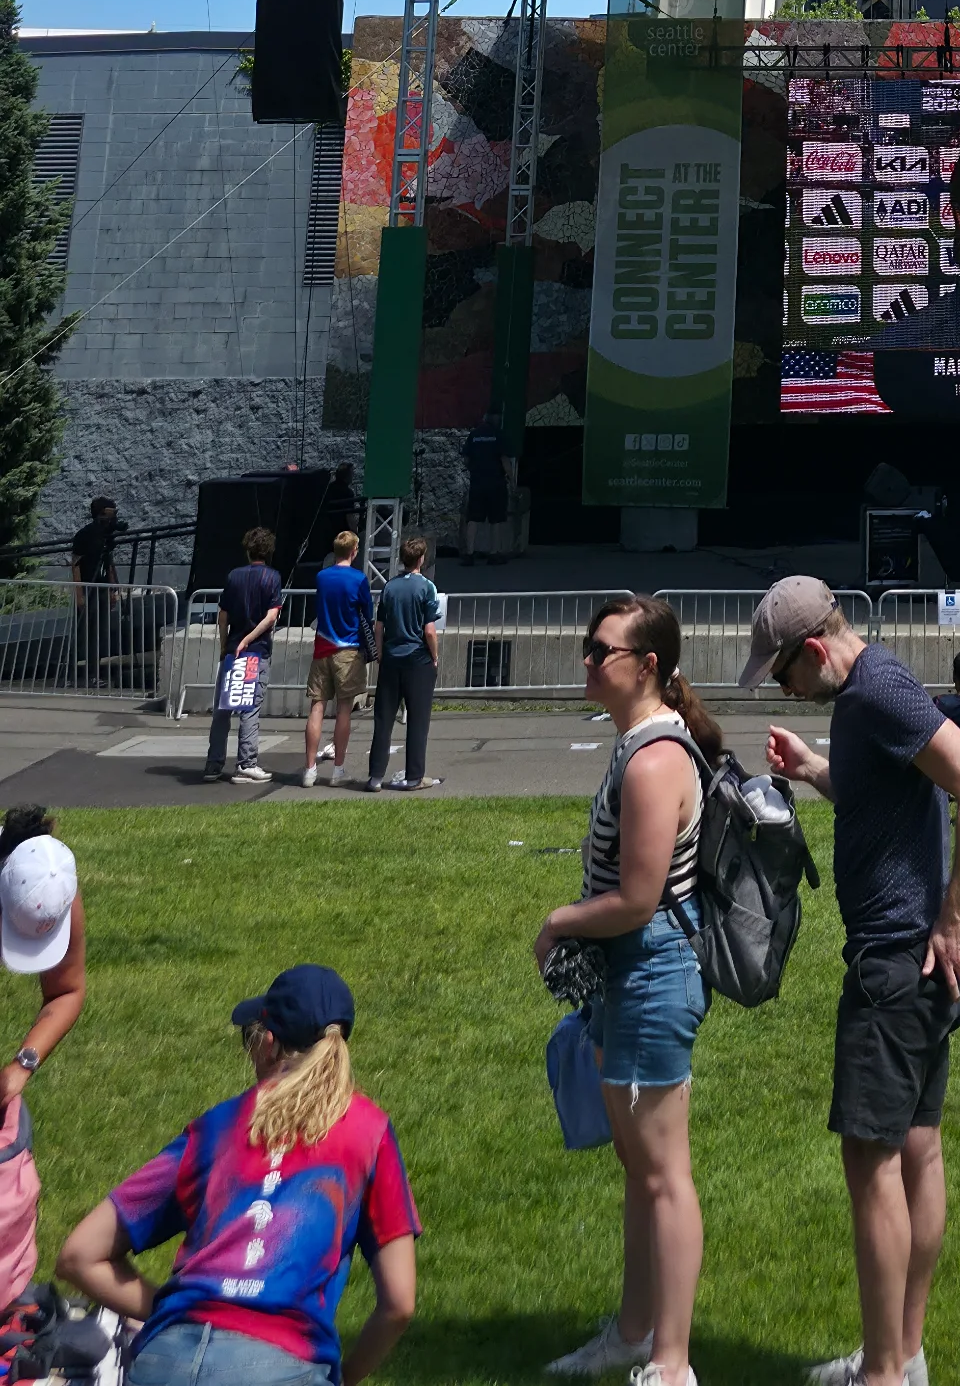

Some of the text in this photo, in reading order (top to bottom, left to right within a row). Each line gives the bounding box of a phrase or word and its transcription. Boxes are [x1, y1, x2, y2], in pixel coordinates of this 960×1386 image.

[647, 23, 704, 40] seattle
[649, 40, 702, 56] center
[876, 156, 928, 171] KIA
[673, 163, 721, 184] AT THE
[890, 199, 928, 215] ADI
[610, 163, 666, 340] CONNECT
[804, 249, 860, 265] Lenovo
[875, 244, 928, 262] QATAR
[665, 188, 720, 340] CENTER
[805, 300, 858, 310] aramco
[608, 474, 702, 487] seattlecenter.com
[229, 656, 248, 707] WORLD
[240, 656, 259, 706] SEA THE
